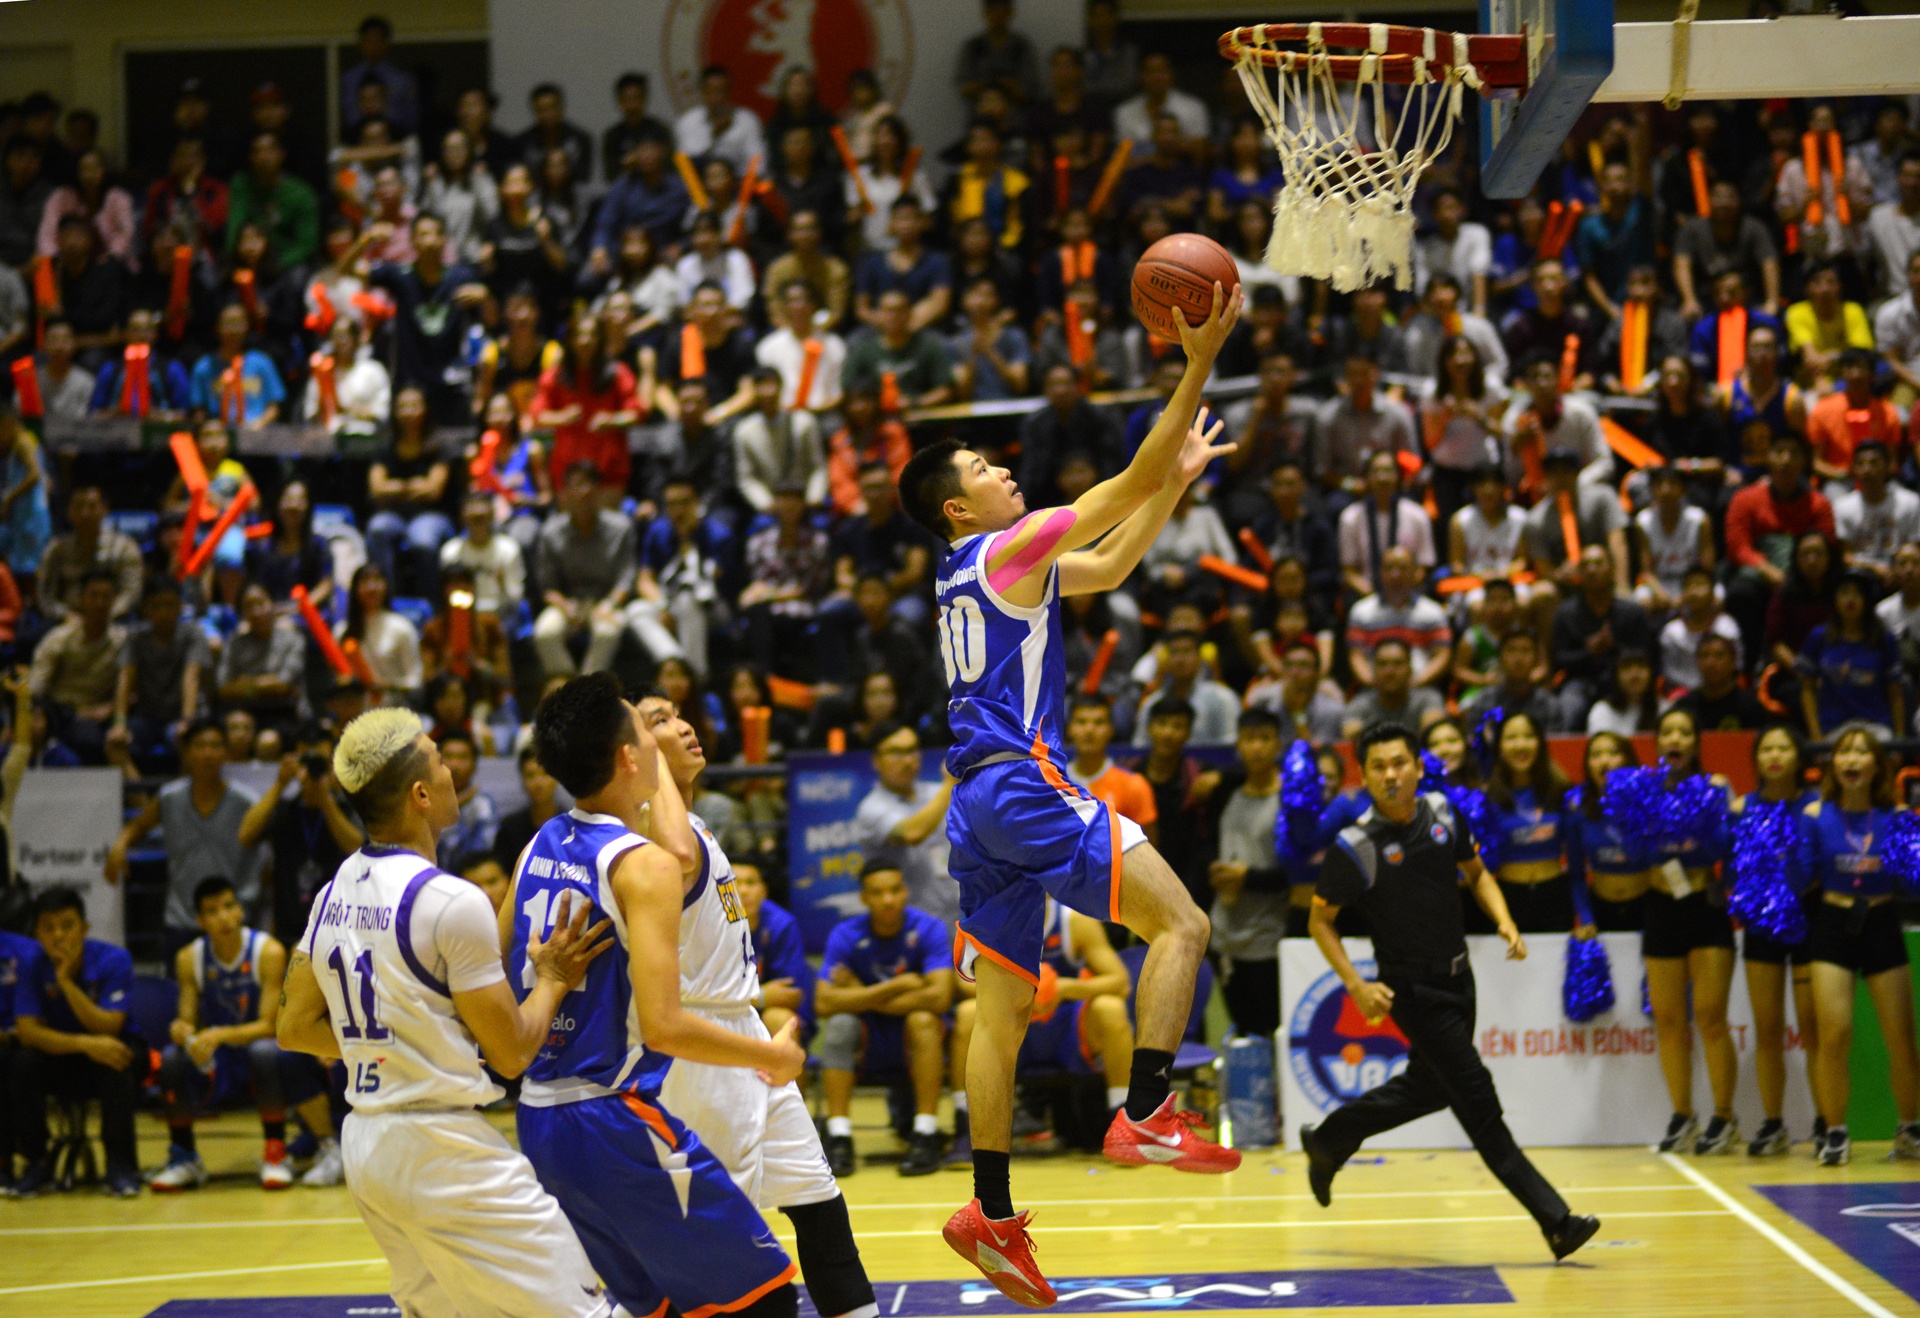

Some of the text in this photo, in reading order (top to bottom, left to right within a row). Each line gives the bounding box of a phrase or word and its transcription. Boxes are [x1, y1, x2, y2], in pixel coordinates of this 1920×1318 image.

[1150, 275, 1181, 296] 500
[1137, 297, 1180, 332] LDING
[356, 905, 392, 931] TRUNG
[327, 941, 394, 1043] 11
[551, 1012, 576, 1032] alo
[1481, 1026, 1516, 1057] IÊN
[1592, 1023, 1656, 1056] BÓNG
[355, 1062, 381, 1093] LS
